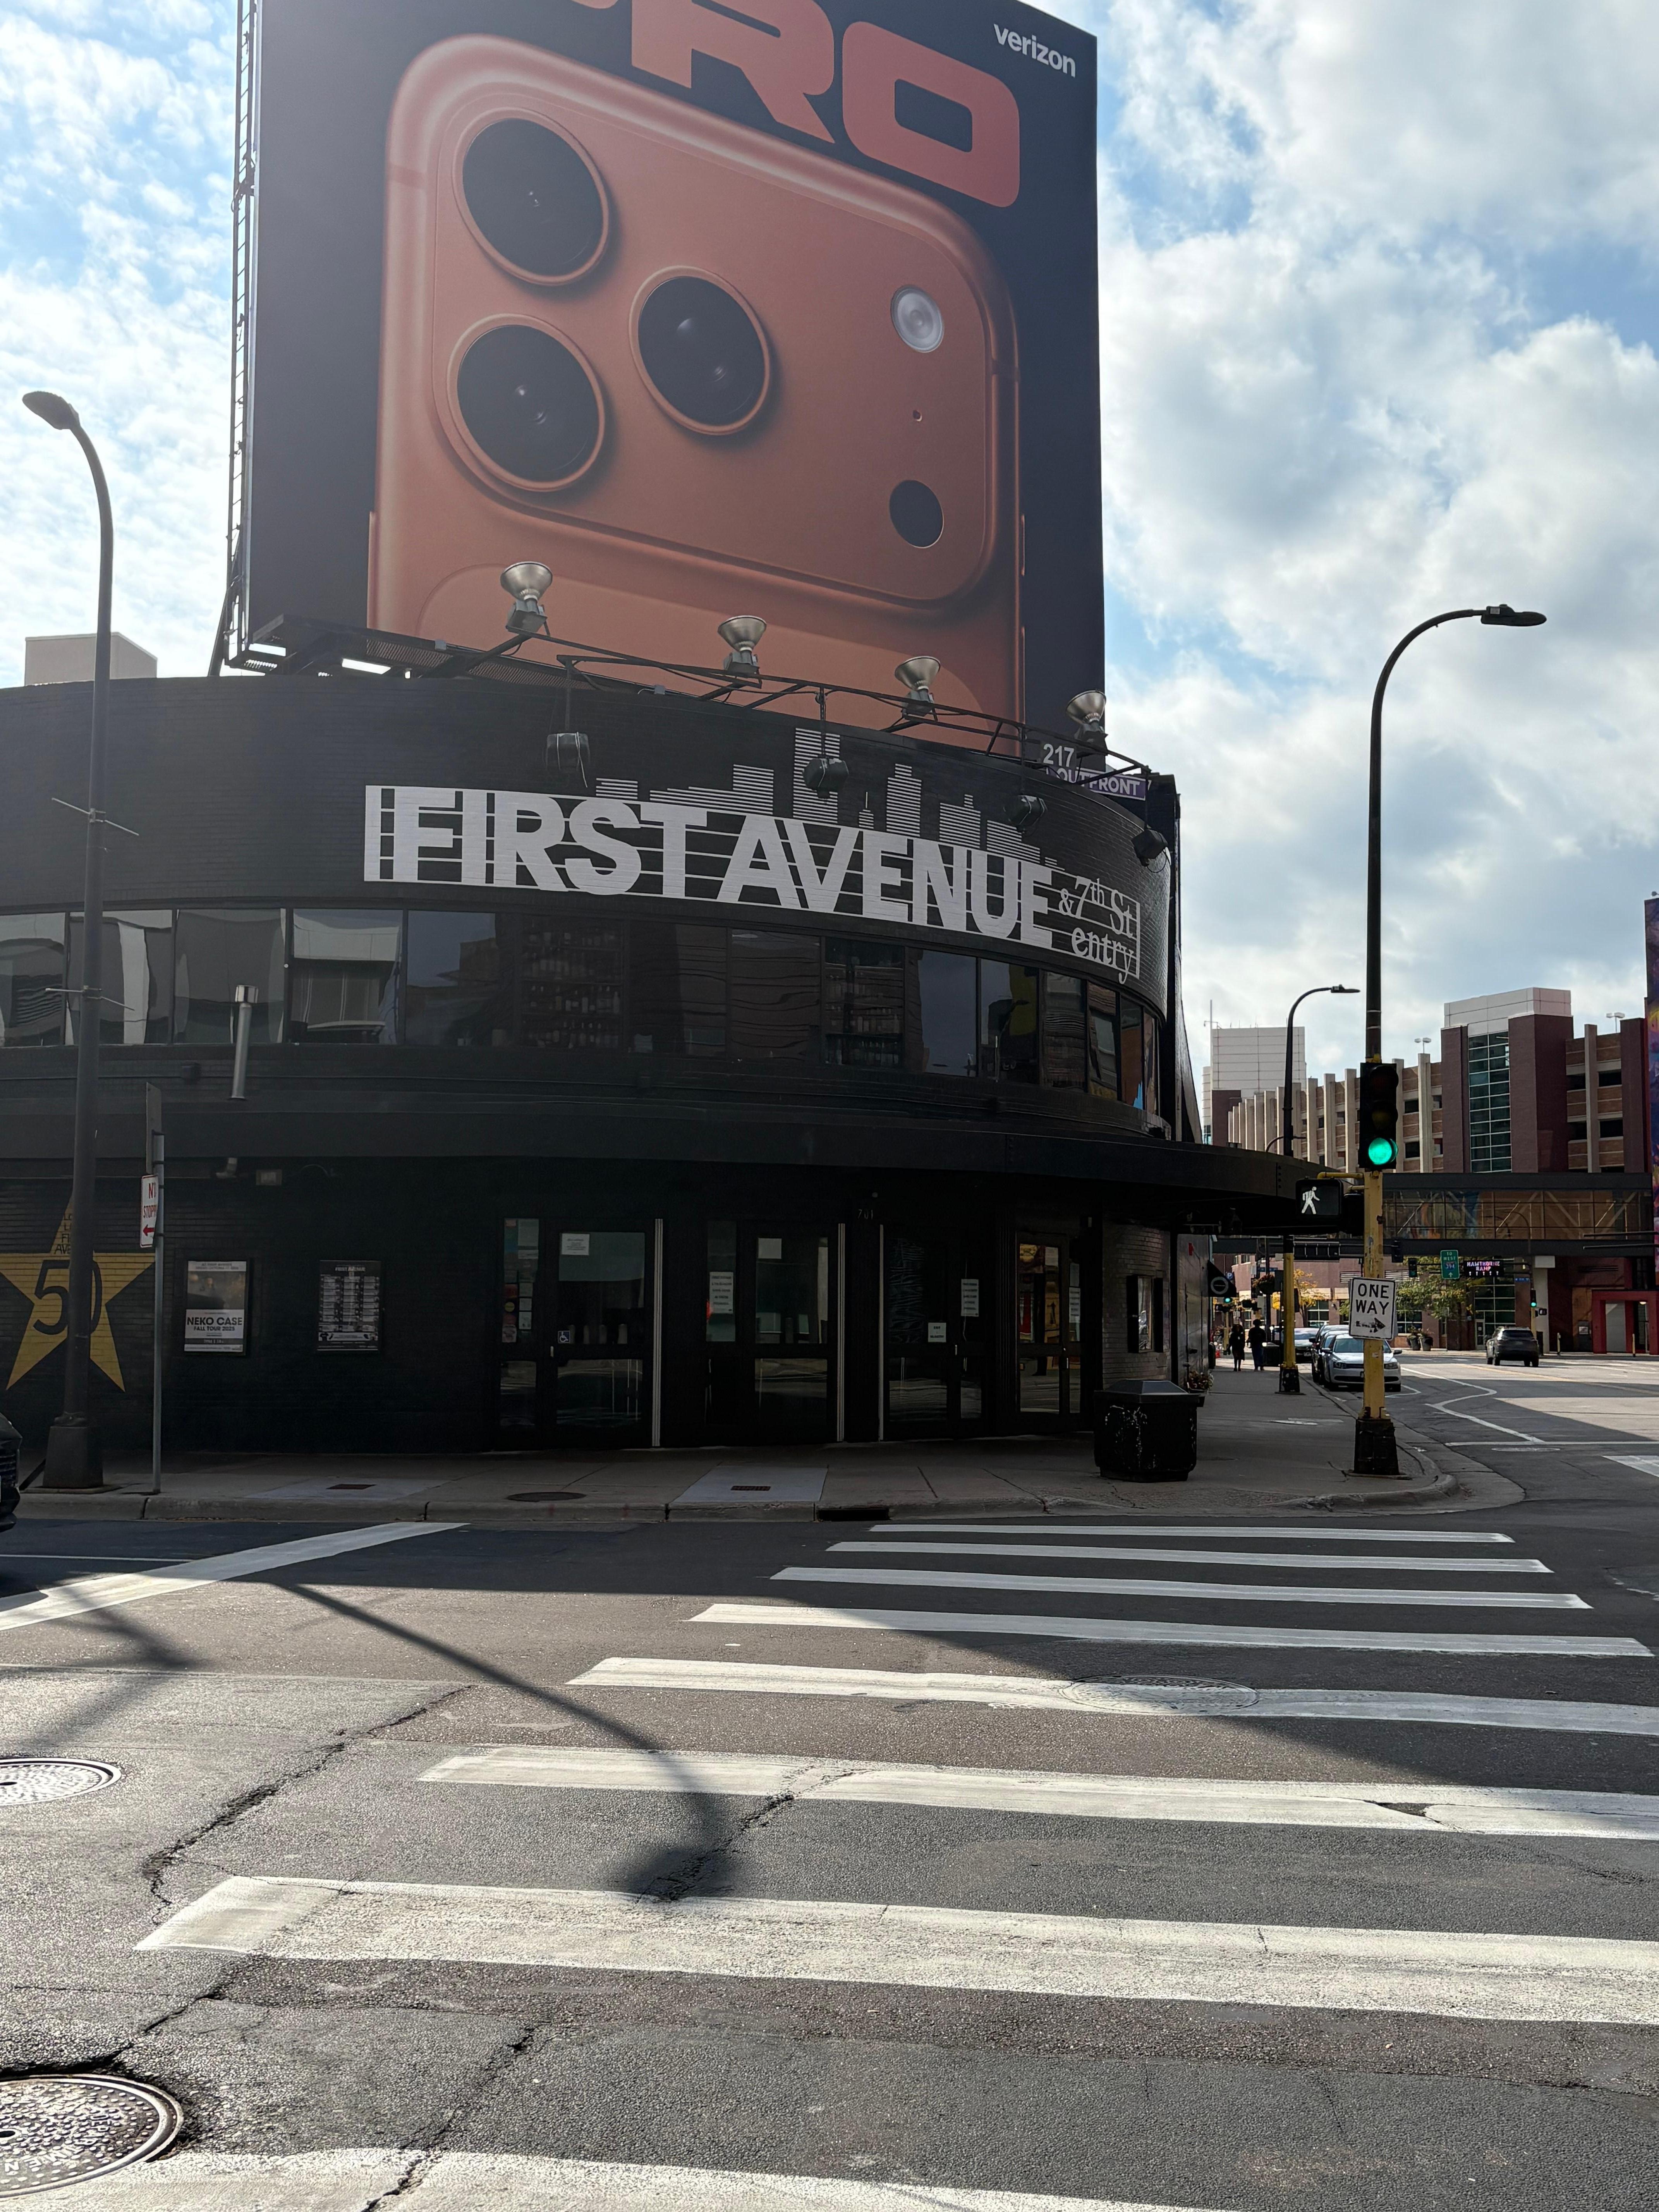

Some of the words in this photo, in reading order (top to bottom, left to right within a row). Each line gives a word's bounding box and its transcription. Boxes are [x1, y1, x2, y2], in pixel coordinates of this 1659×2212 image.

[994, 24, 1076, 77] verizon
[571, 0, 1020, 208] RO
[1043, 743, 1075, 767] 217
[1056, 768, 1140, 796] OUTFRONT
[393, 785, 708, 897] FIRST
[716, 813, 1052, 949] AVENUE
[1058, 888, 1074, 916] &
[1110, 893, 1133, 938] St
[1071, 927, 1134, 984] entry
[1356, 1299, 1389, 1315] WAY
[1358, 1283, 1389, 1299] ONE
[187, 1317, 214, 1325] NEKO
[216, 1317, 242, 1325] CASE
